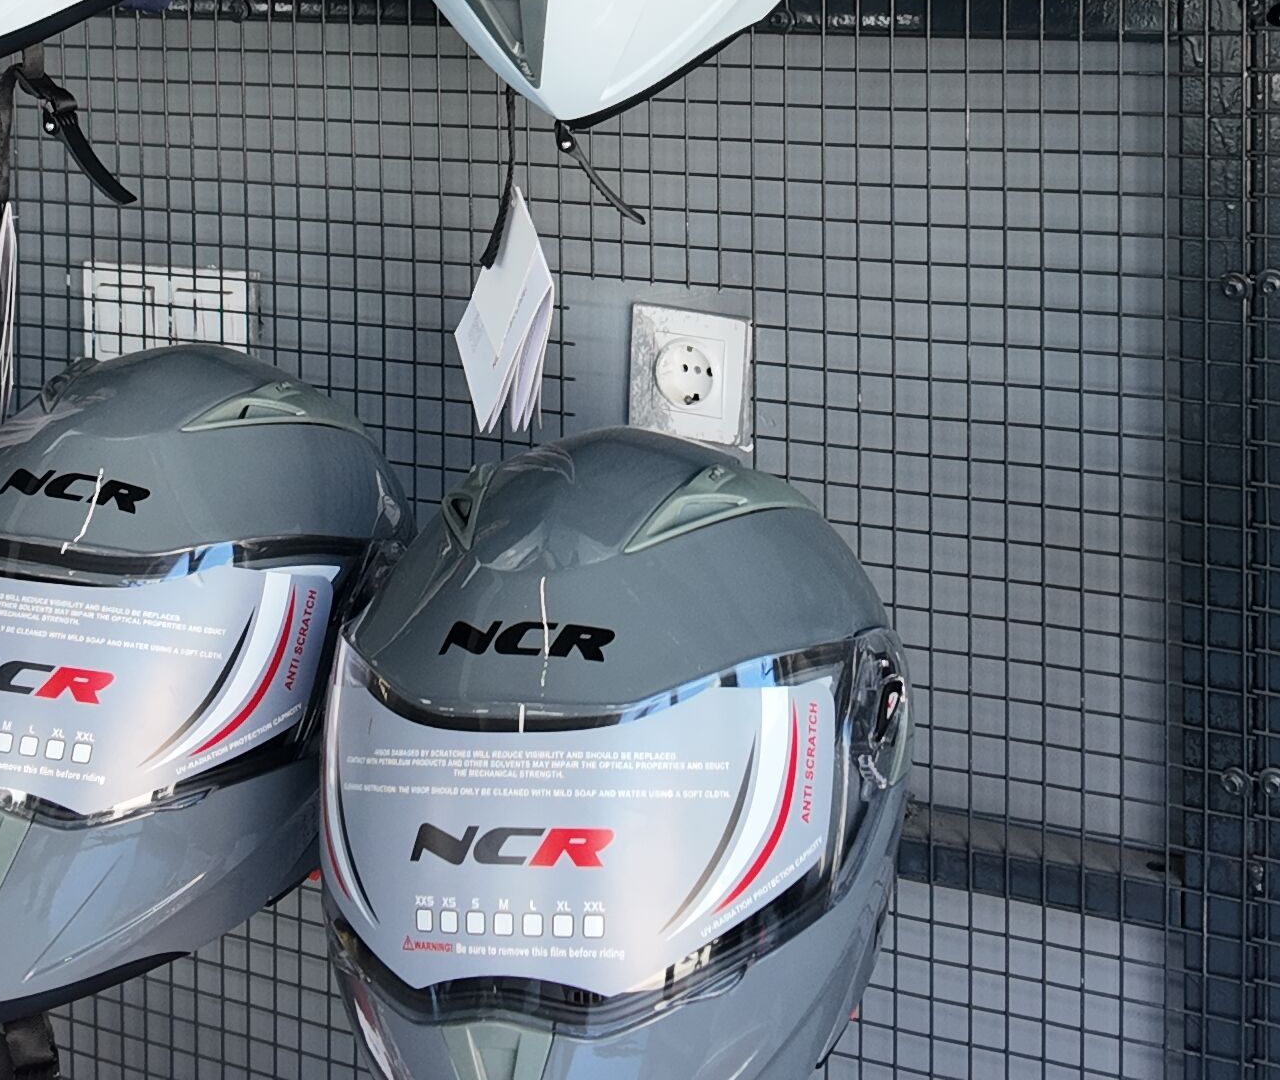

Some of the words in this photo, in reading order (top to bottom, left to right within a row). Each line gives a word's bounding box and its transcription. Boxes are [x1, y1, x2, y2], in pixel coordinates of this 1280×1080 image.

[284, 658, 300, 690] ANTI
[295, 590, 317, 655] SCRATCH
[438, 621, 615, 662] NCR
[2, 721, 12, 731] M
[29, 724, 35, 734] L
[51, 728, 64, 739] XL
[75, 731, 95, 742] XXL
[805, 703, 818, 780] SCRATCH
[448, 759, 462, 767] AND
[532, 761, 550, 769] MAY
[599, 762, 633, 770] OPTICAL
[687, 762, 703, 770] AND
[621, 752, 631, 760] BE
[460, 788, 479, 796] ONLY
[481, 788, 491, 796] BE
[493, 788, 529, 797] CLEANED
[575, 790, 597, 798] SOAP
[599, 790, 616, 798] AND
[683, 791, 703, 799] SOFT
[802, 785, 813, 824] ANTI
[409, 823, 615, 867] NCR
[753, 867, 795, 900] PROTECTION
[415, 895, 434, 906] XXS
[442, 897, 456, 907] XS
[472, 898, 479, 909] S
[499, 900, 509, 910] M
[530, 900, 536, 911] L
[557, 901, 571, 911] XL
[584, 901, 605, 912] XXL
[415, 942, 453, 952] WARNING!
[456, 943, 466, 954] Be
[469, 946, 485, 956] sure
[488, 946, 497, 956] to
[499, 948, 529, 957] remove
[531, 947, 548, 957] this
[550, 947, 566, 957] film
[569, 948, 596, 958] before
[599, 948, 625, 960] riding
